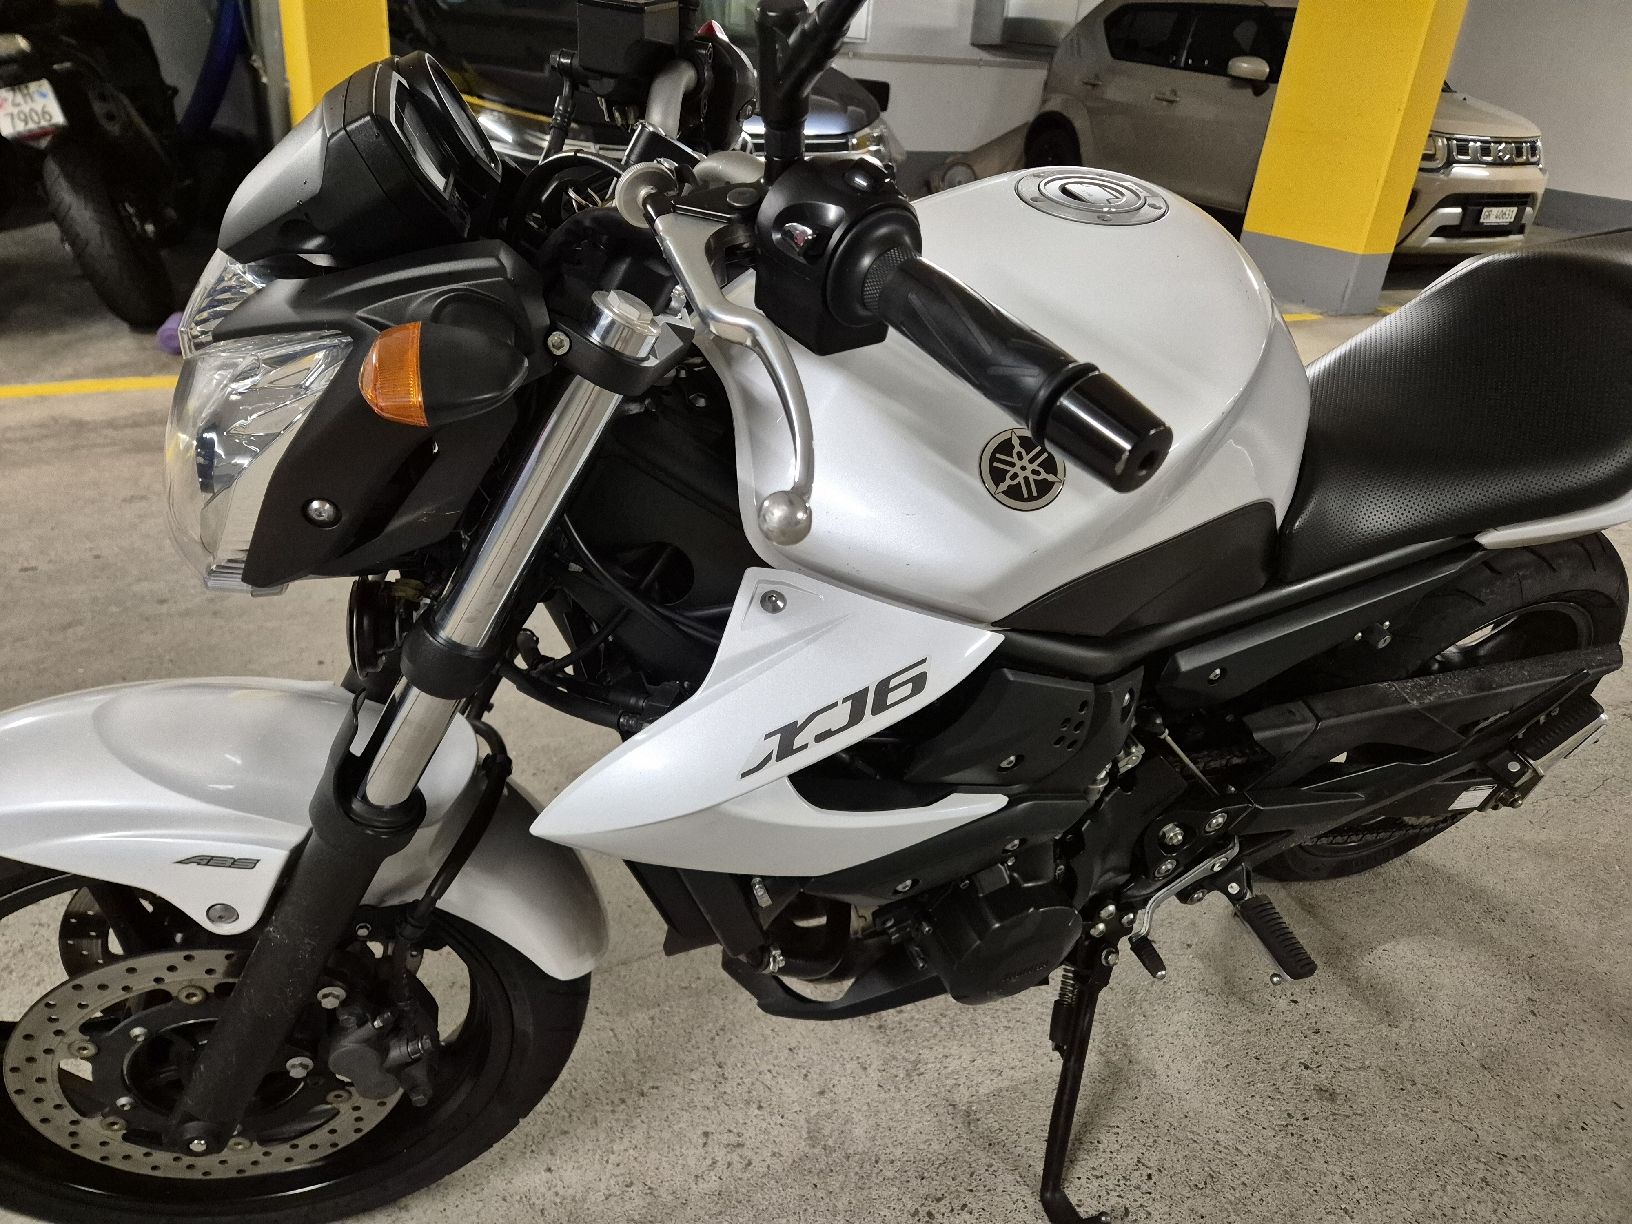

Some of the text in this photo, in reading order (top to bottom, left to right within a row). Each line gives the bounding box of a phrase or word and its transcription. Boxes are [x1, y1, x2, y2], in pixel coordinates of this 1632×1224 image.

[3, 104, 53, 131] 7906
[740, 656, 928, 780] XJ6
[173, 854, 261, 870] ABS
